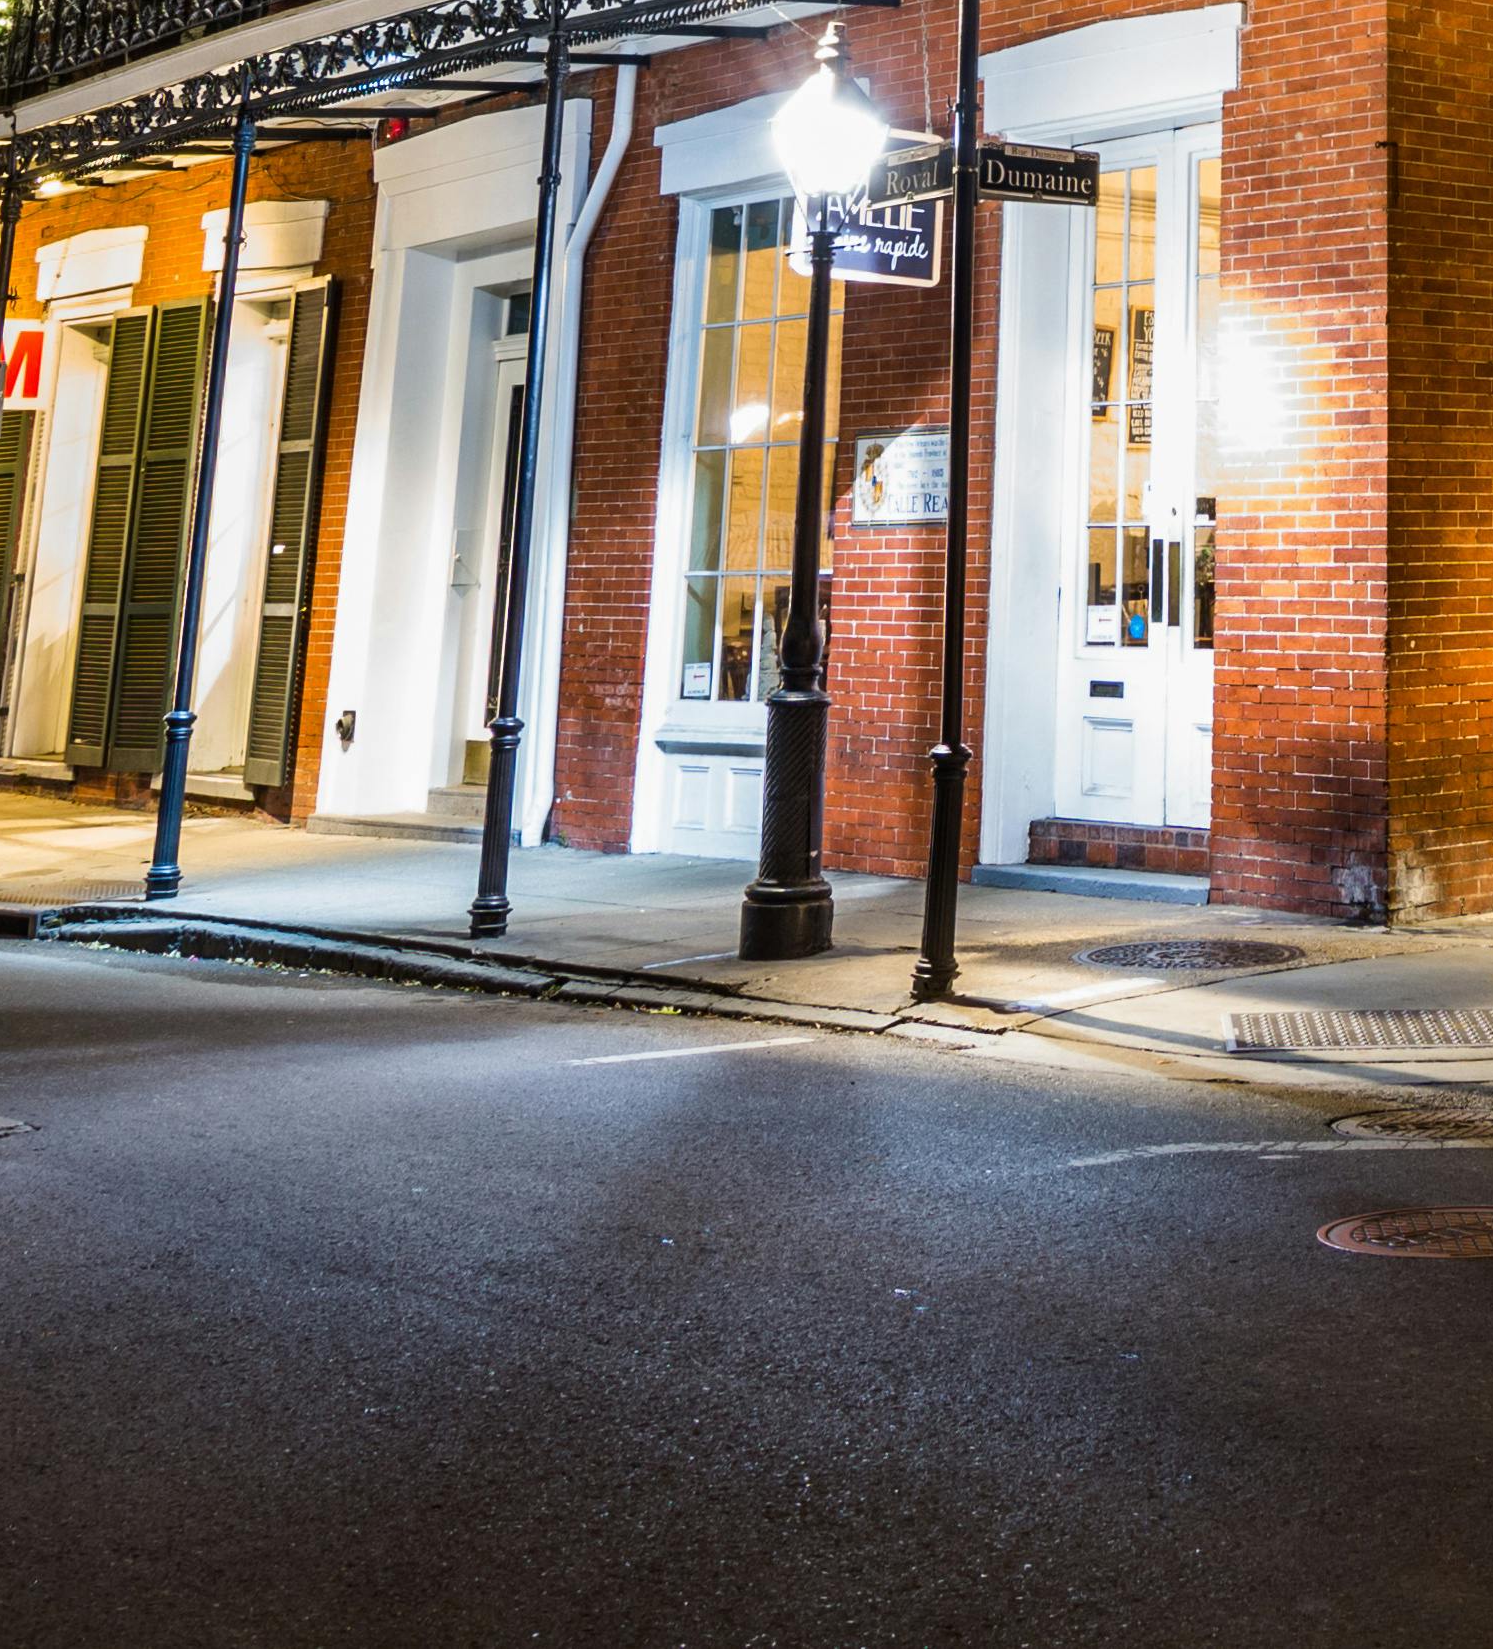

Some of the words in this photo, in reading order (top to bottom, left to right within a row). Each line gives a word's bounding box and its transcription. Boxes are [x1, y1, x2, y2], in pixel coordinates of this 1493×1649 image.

[886, 161, 938, 195] Royal
[987, 159, 1092, 194] Dumaine
[873, 233, 929, 271] rapide
[923, 492, 948, 513] REA
